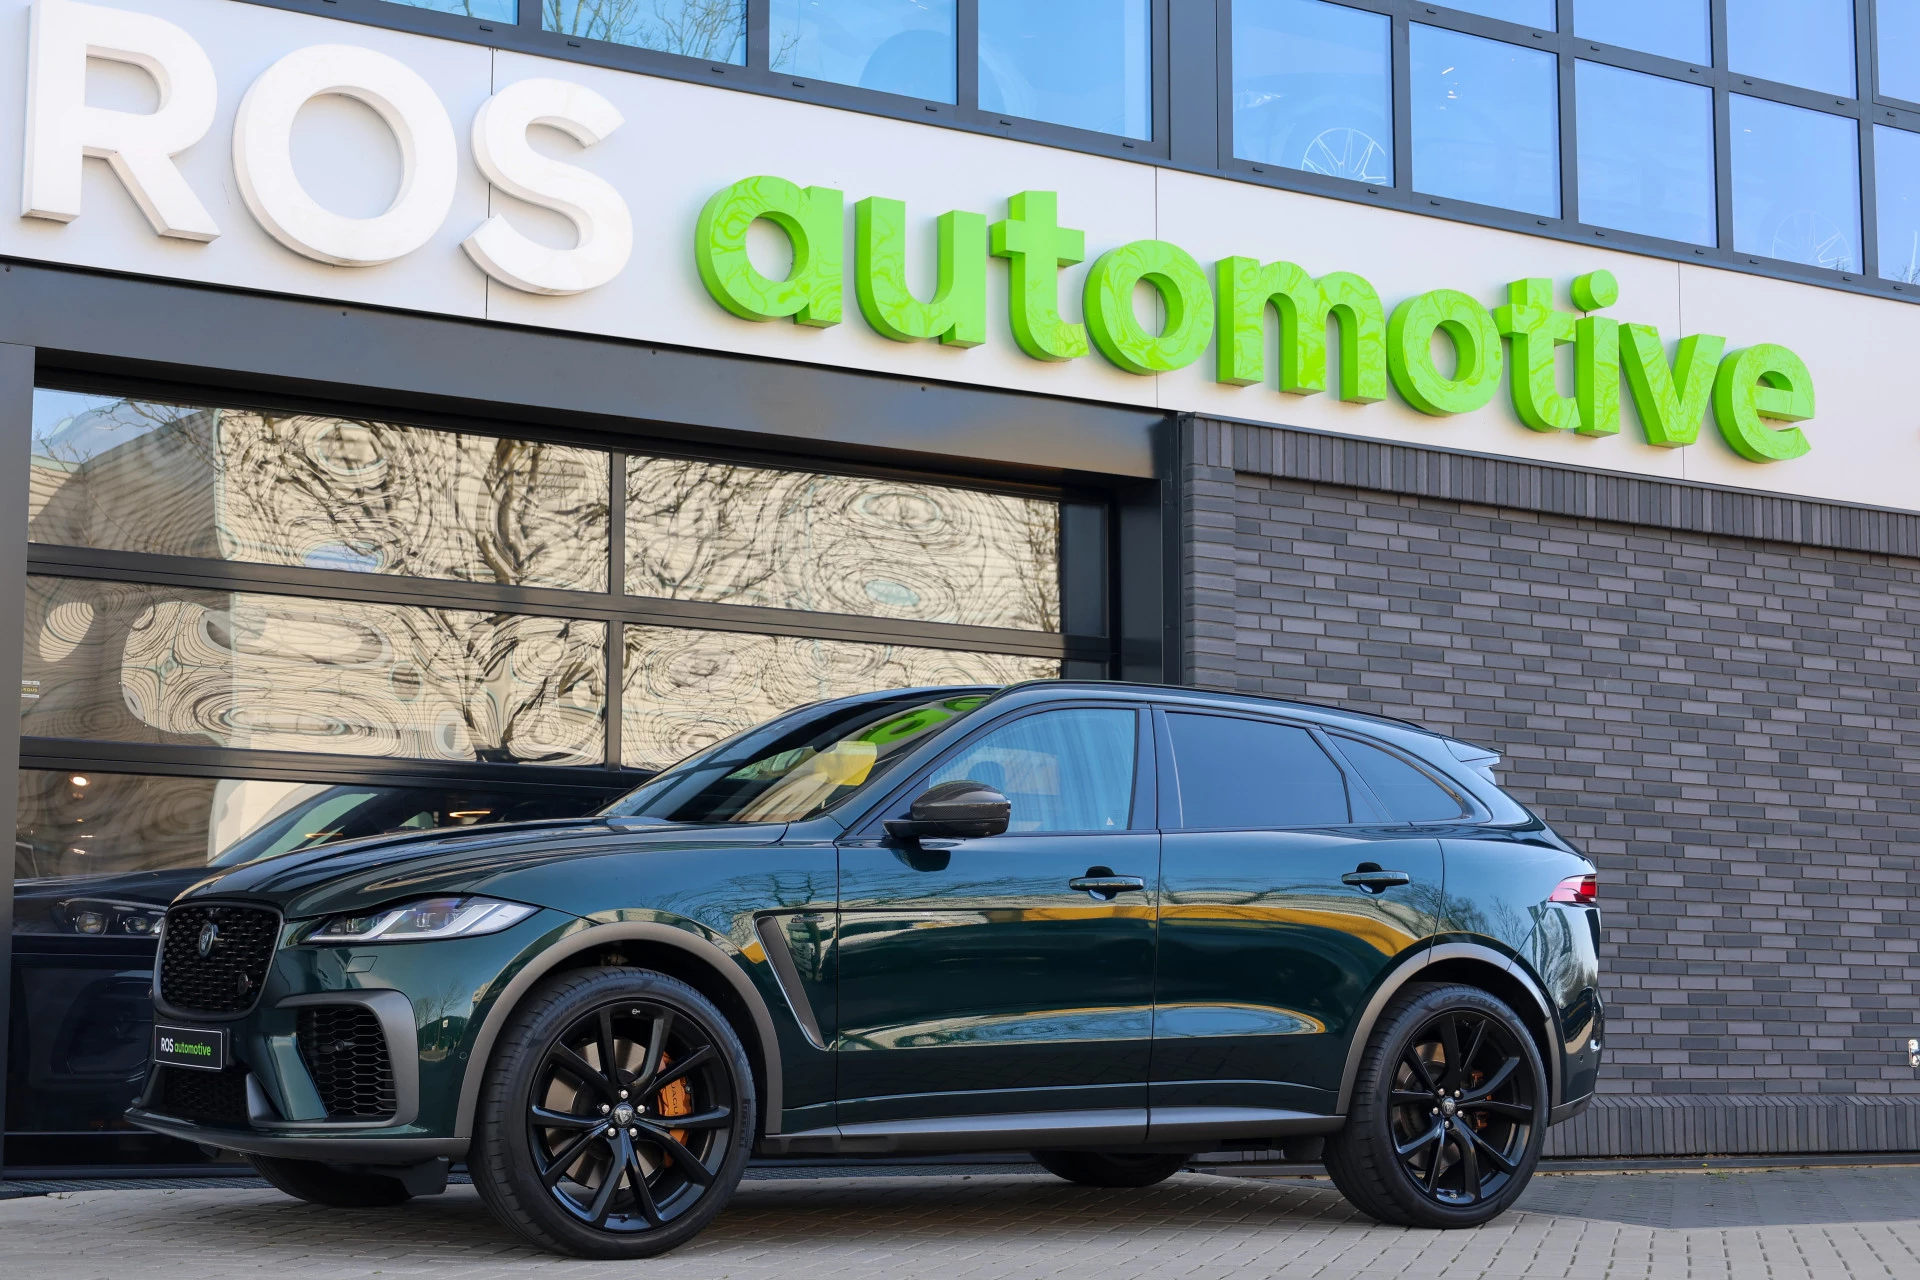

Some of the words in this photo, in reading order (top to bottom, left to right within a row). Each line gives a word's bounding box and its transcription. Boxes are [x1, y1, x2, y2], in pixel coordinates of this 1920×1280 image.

[20, 0, 633, 295] ROS
[695, 175, 1815, 464] automotive
[160, 1037, 174, 1053] ROS
[174, 1041, 212, 1056] automotive
